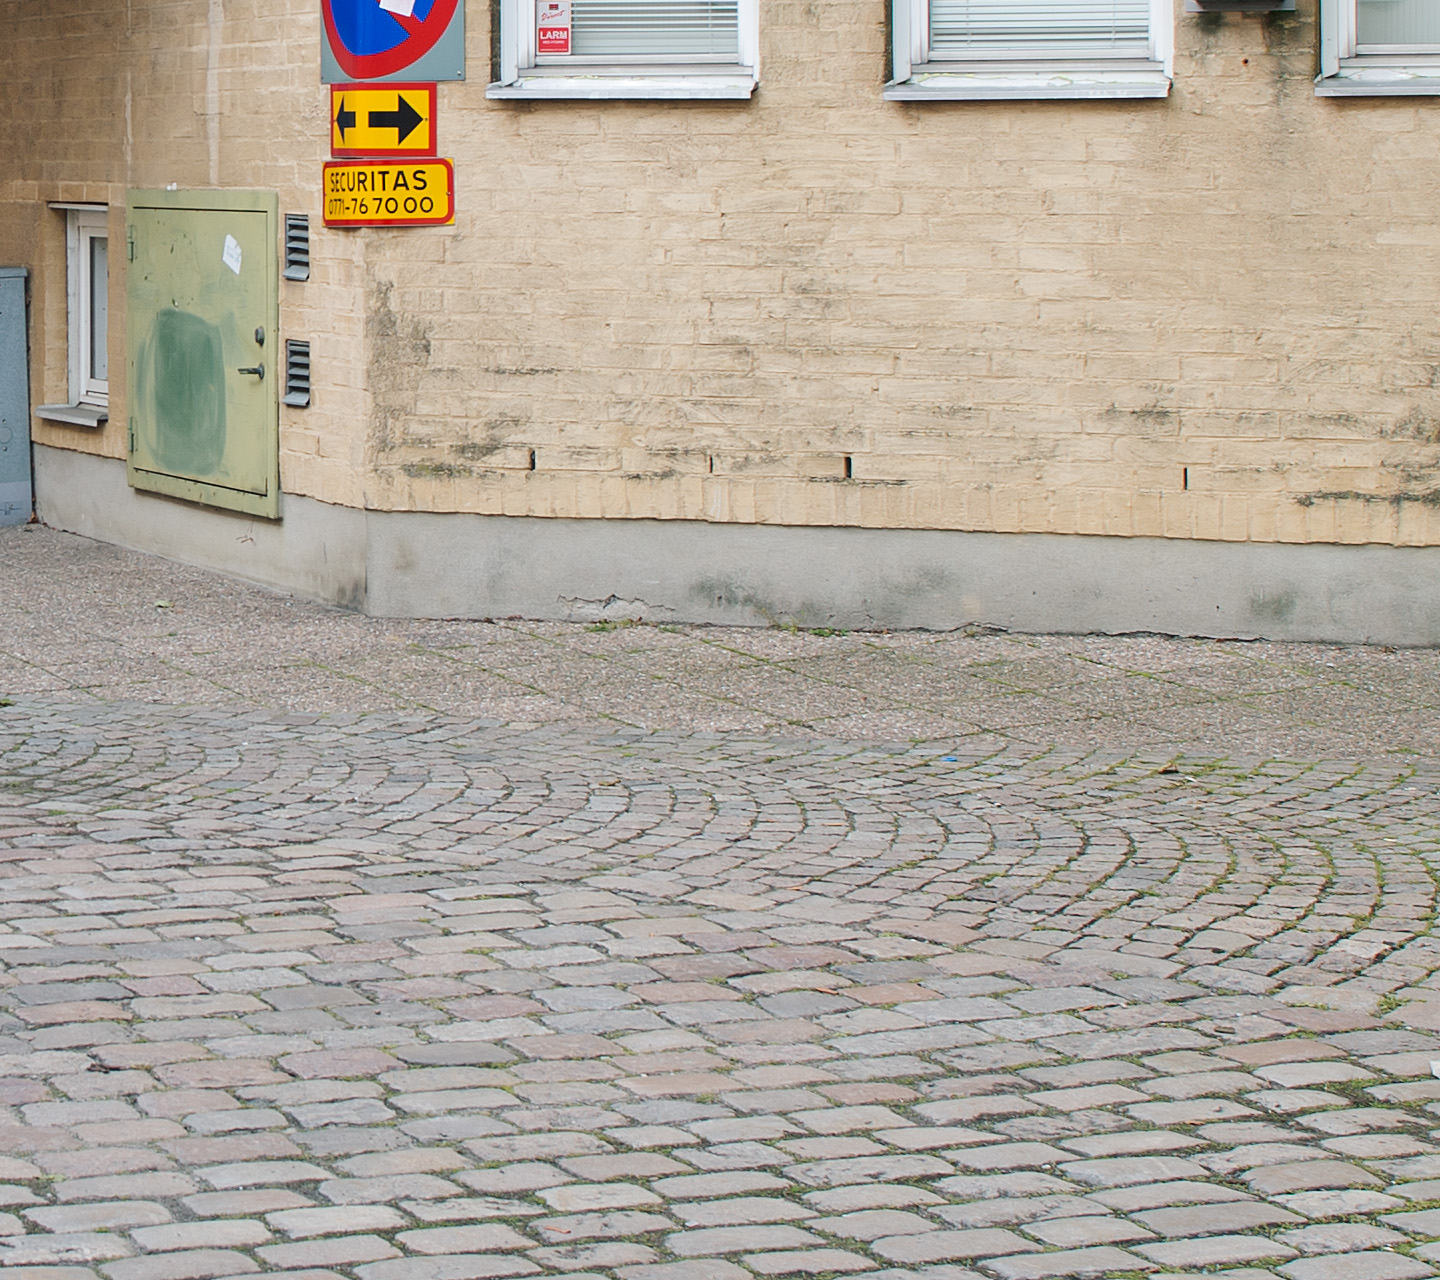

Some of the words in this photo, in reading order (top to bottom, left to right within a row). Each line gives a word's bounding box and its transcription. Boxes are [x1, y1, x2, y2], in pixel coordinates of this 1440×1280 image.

[540, 30, 568, 40] LARM
[330, 169, 428, 193] SECURITAS
[372, 196, 399, 215] 70
[403, 196, 434, 214] 00
